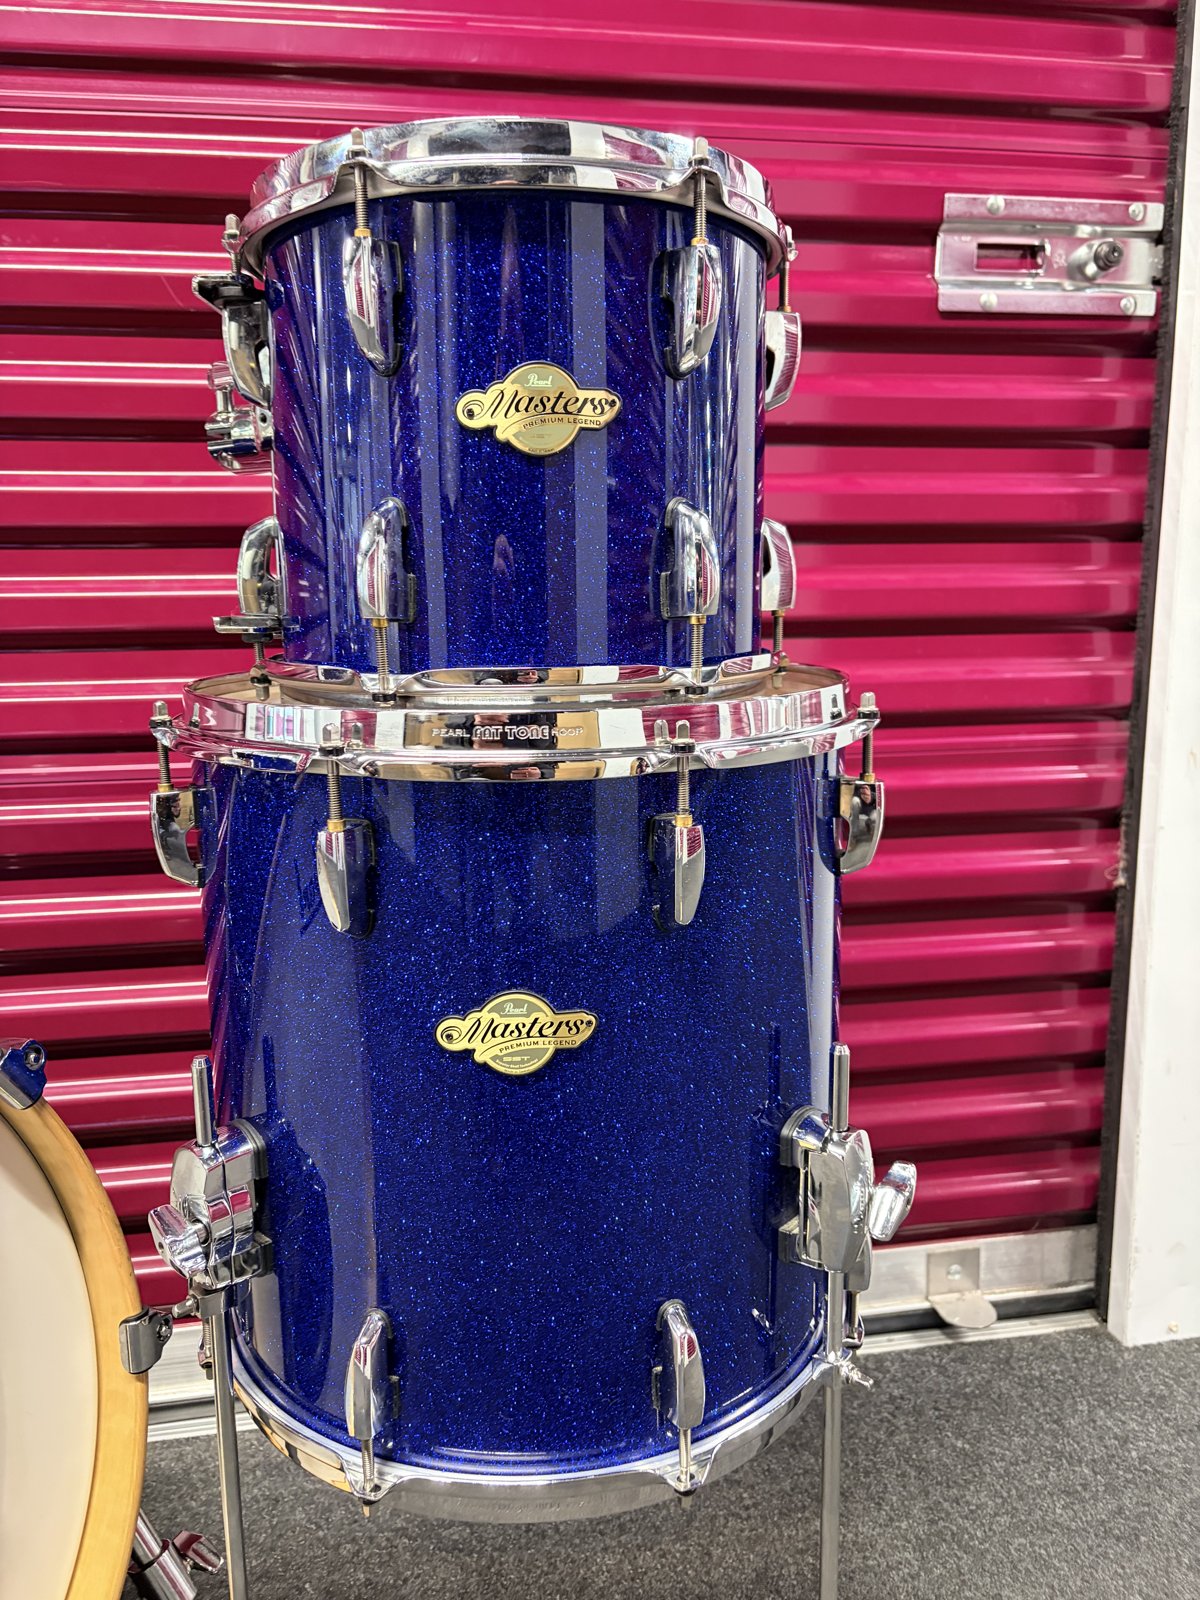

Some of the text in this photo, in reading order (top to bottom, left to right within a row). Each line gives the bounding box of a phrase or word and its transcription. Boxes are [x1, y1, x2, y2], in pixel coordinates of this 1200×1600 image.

[525, 373, 552, 386] Pearl
[462, 389, 616, 419] Masters
[522, 418, 602, 429] PREMIUM LEGEND
[432, 725, 583, 740] PEARL FAT TONE HOOP
[501, 1003, 528, 1014] Pearl
[441, 1016, 593, 1044] Masters
[499, 1040, 539, 1053] PREMIUM
